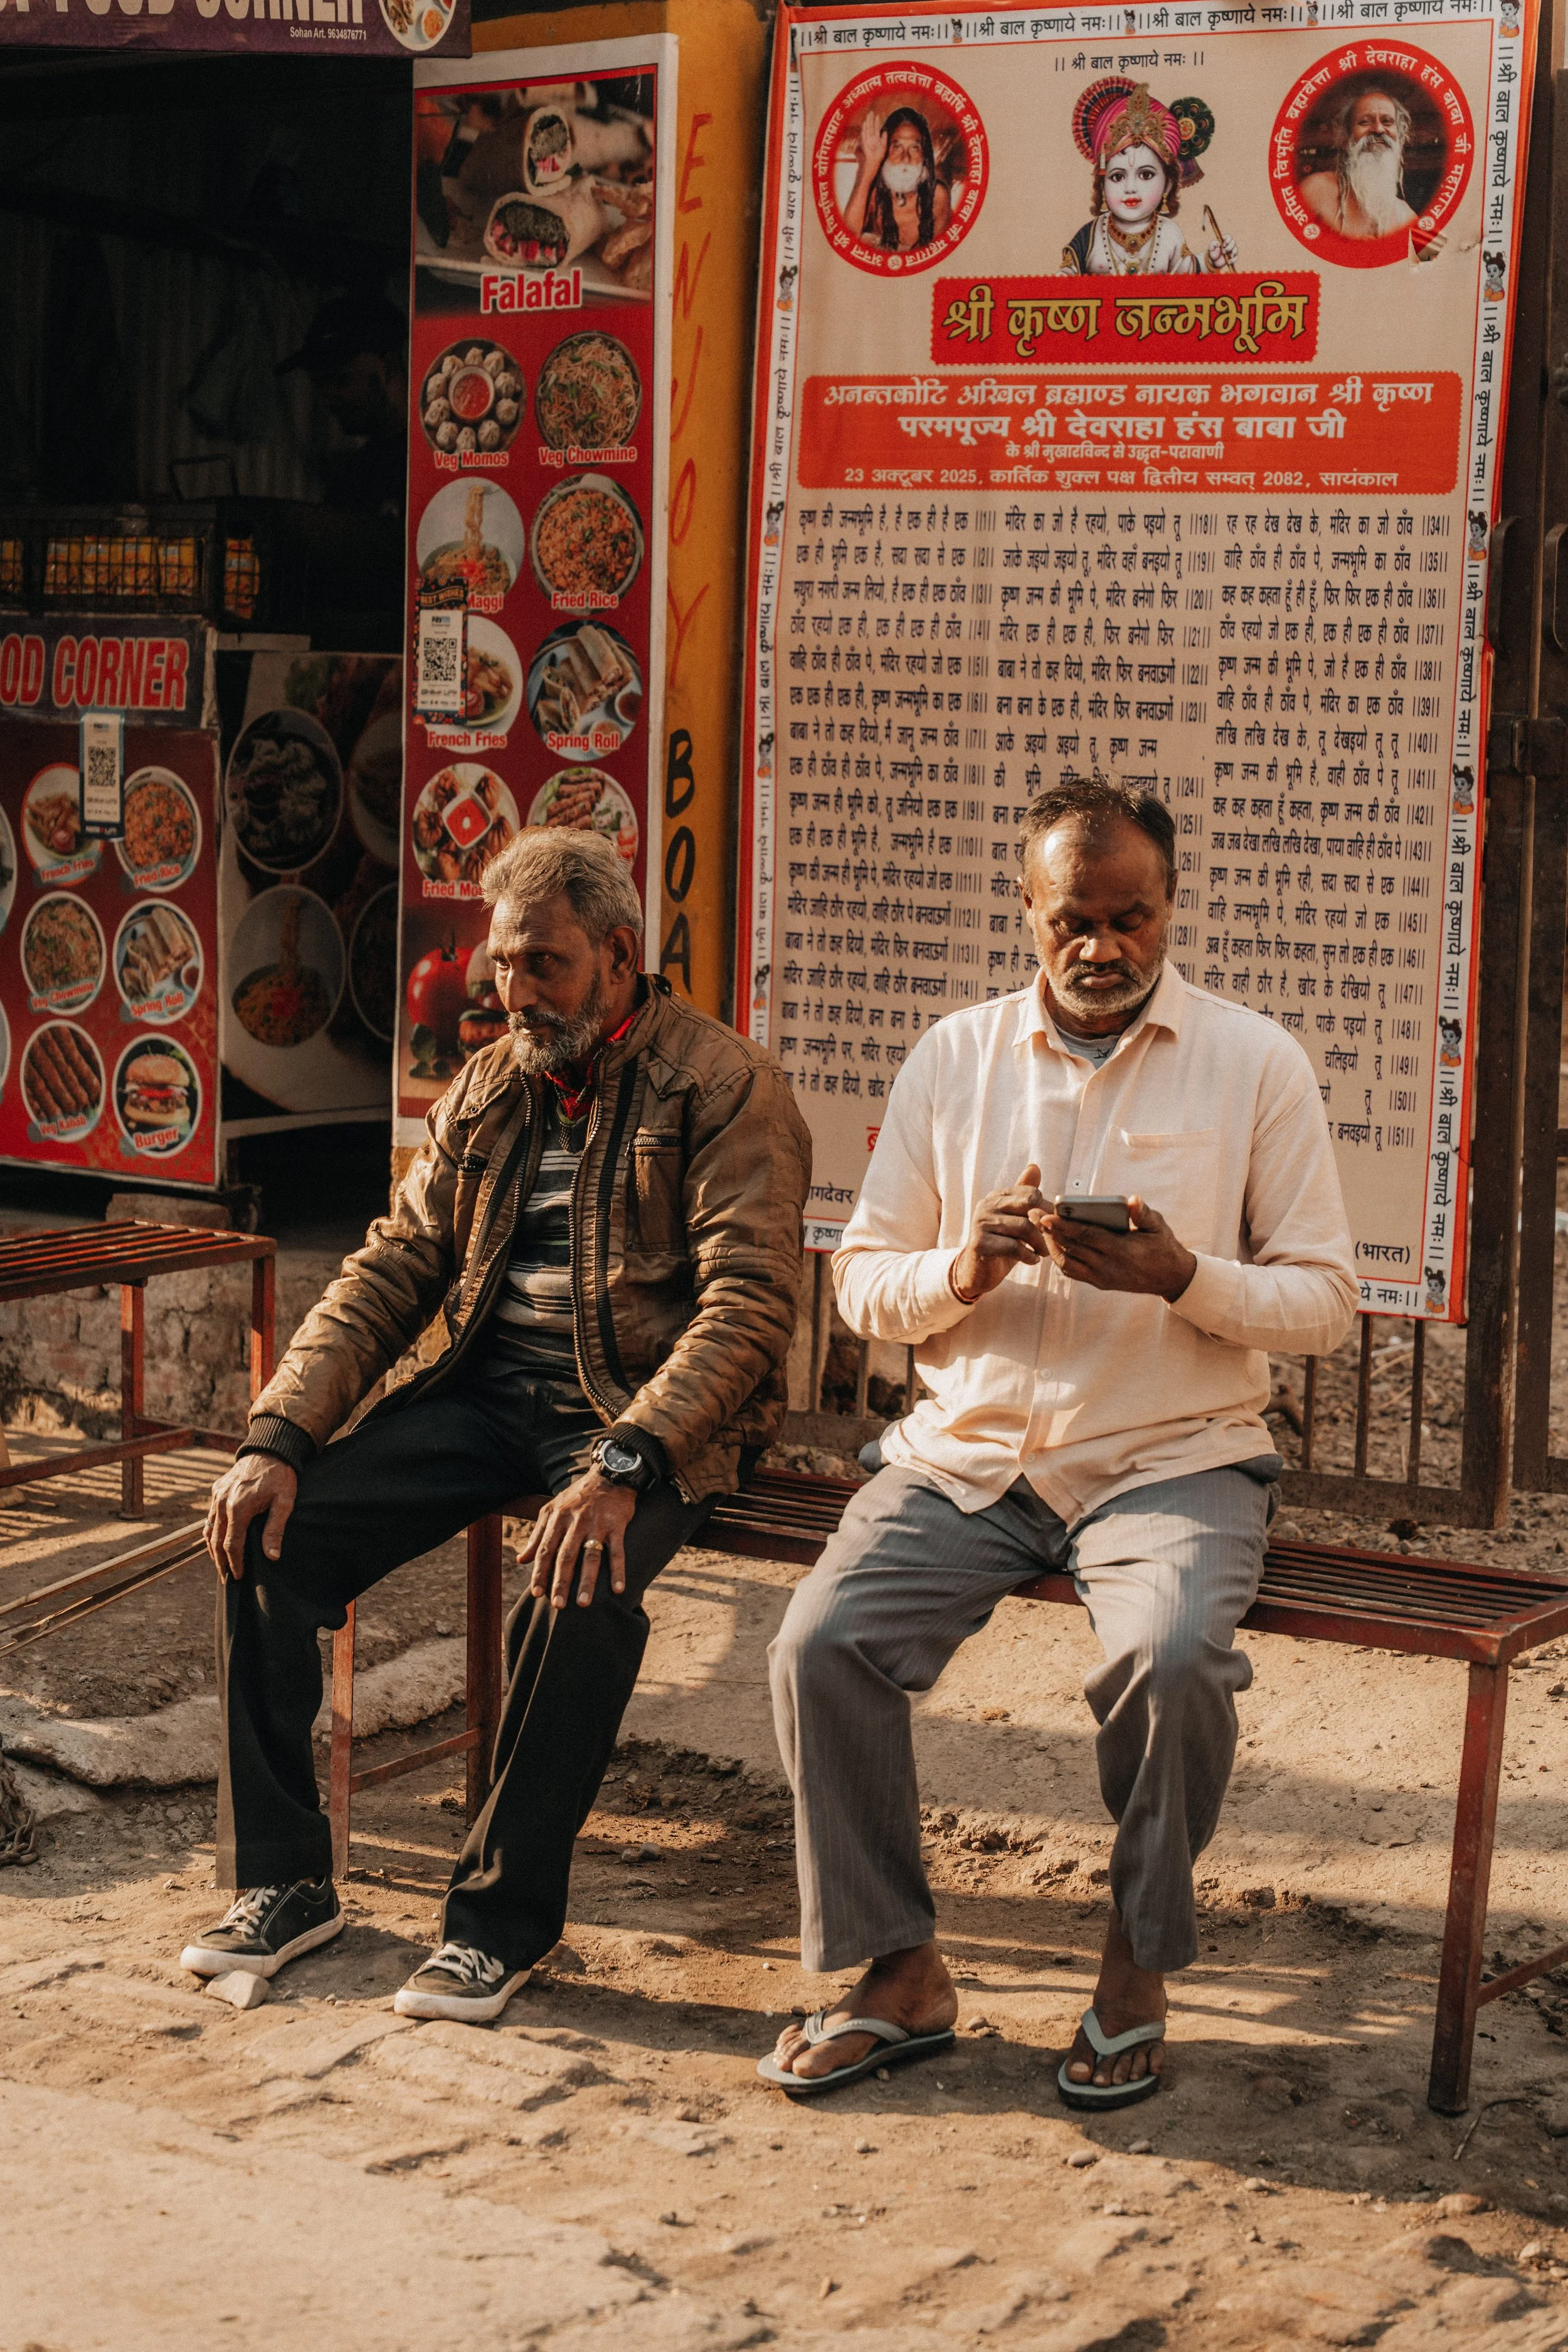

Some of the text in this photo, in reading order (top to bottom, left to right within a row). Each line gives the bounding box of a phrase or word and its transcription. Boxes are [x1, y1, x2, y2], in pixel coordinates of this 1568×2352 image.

[1000, 20, 1025, 35] बाल
[1030, 12, 1076, 40] कृष्णाये
[1174, 11, 1202, 26] बाल
[1207, 1, 1256, 31] कृष्णाये
[290, 26, 367, 40] Sohan Art. 9634876771
[832, 28, 857, 43] बाल
[862, 21, 906, 48] कृष्णाये
[1071, 49, 1185, 73] श्री बाल कृष्णाये नमः
[1339, 50, 1357, 71] श्री
[1365, 45, 1417, 70] देवराहा
[1420, 64, 1444, 88] हंस
[1443, 89, 1465, 125] बाबा
[1495, 90, 1510, 123] बाल
[961, 115, 978, 133] श्री
[1273, 127, 1293, 180] विभूति
[1455, 132, 1471, 154] जी
[969, 134, 983, 185] देवराहा
[1429, 163, 1465, 218] महाराज
[959, 189, 978, 223] बाबा
[1281, 186, 1308, 226] अमित
[906, 238, 948, 267] महाराज
[480, 269, 582, 313] Falafal
[941, 280, 1310, 358] श्री कृष्ण जन्मभूमि
[824, 375, 1434, 412] अनन्तकोटि अखिल ब्रह्माण्ड नायक भगवान श्री कृष्ण
[898, 408, 1347, 446] परमपूज्य श्री देवराहा हंस बाबा जी
[435, 447, 509, 471] Veg Momos
[539, 446, 637, 467] Veg Chowmine
[1005, 440, 1021, 458] के
[1023, 439, 1041, 458] श्री
[1041, 440, 1111, 464] मुखारविन्द
[1112, 440, 1126, 458] से
[844, 468, 864, 482] 23
[871, 469, 934, 487] अक्टूबर
[990, 464, 1049, 484] कार्तिक
[1054, 470, 1101, 490] शुक्ल
[1106, 470, 1136, 484] पक्ष
[1142, 466, 1199, 486] द्वितीय
[1205, 472, 1256, 490] सम्वत्
[1318, 468, 1399, 487] सायंकाल
[1005, 504, 1027, 531] मंदिर
[1034, 512, 1046, 531] का
[1052, 506, 1064, 531] जो
[1071, 506, 1078, 534] है
[1118, 507, 1136, 532] पाके
[1173, 514, 1181, 542] तू
[1226, 514, 1239, 534] रह
[1245, 514, 1258, 536] रह
[1264, 508, 1280, 533] देख
[1286, 509, 1303, 533] देख
[1330, 508, 1351, 534] मंदिर
[1358, 516, 1370, 534] का
[1377, 509, 1389, 534] जो
[1397, 509, 1414, 535] ठाँव
[551, 592, 618, 609] Fried Rice
[53, 635, 189, 711] CORNER
[1217, 684, 1236, 712] वाहि
[1241, 684, 1258, 710] ठाँव
[1264, 685, 1273, 712] ही
[1280, 686, 1296, 711] ठाँव
[1320, 687, 1341, 712] मंदिर
[1348, 696, 1360, 714] का
[1367, 696, 1381, 715] एक
[1388, 689, 1404, 716] ठाँव
[427, 731, 507, 748] French Fries
[548, 733, 619, 750] Spring Roll
[423, 879, 455, 898] Fried
[1207, 895, 1227, 922] वाहि
[1234, 898, 1270, 930] जन्मभूमि
[1295, 900, 1317, 925] मंदिर
[1325, 903, 1348, 929] रहयो
[1355, 904, 1367, 928] जो
[1375, 912, 1391, 931] एक
[131, 990, 184, 1018] Spring Roll
[1374, 1055, 1382, 1080] तू
[133, 1126, 179, 1150] Burger
[1375, 1126, 1382, 1152] तू
[1355, 1241, 1411, 1264] (भारत)
